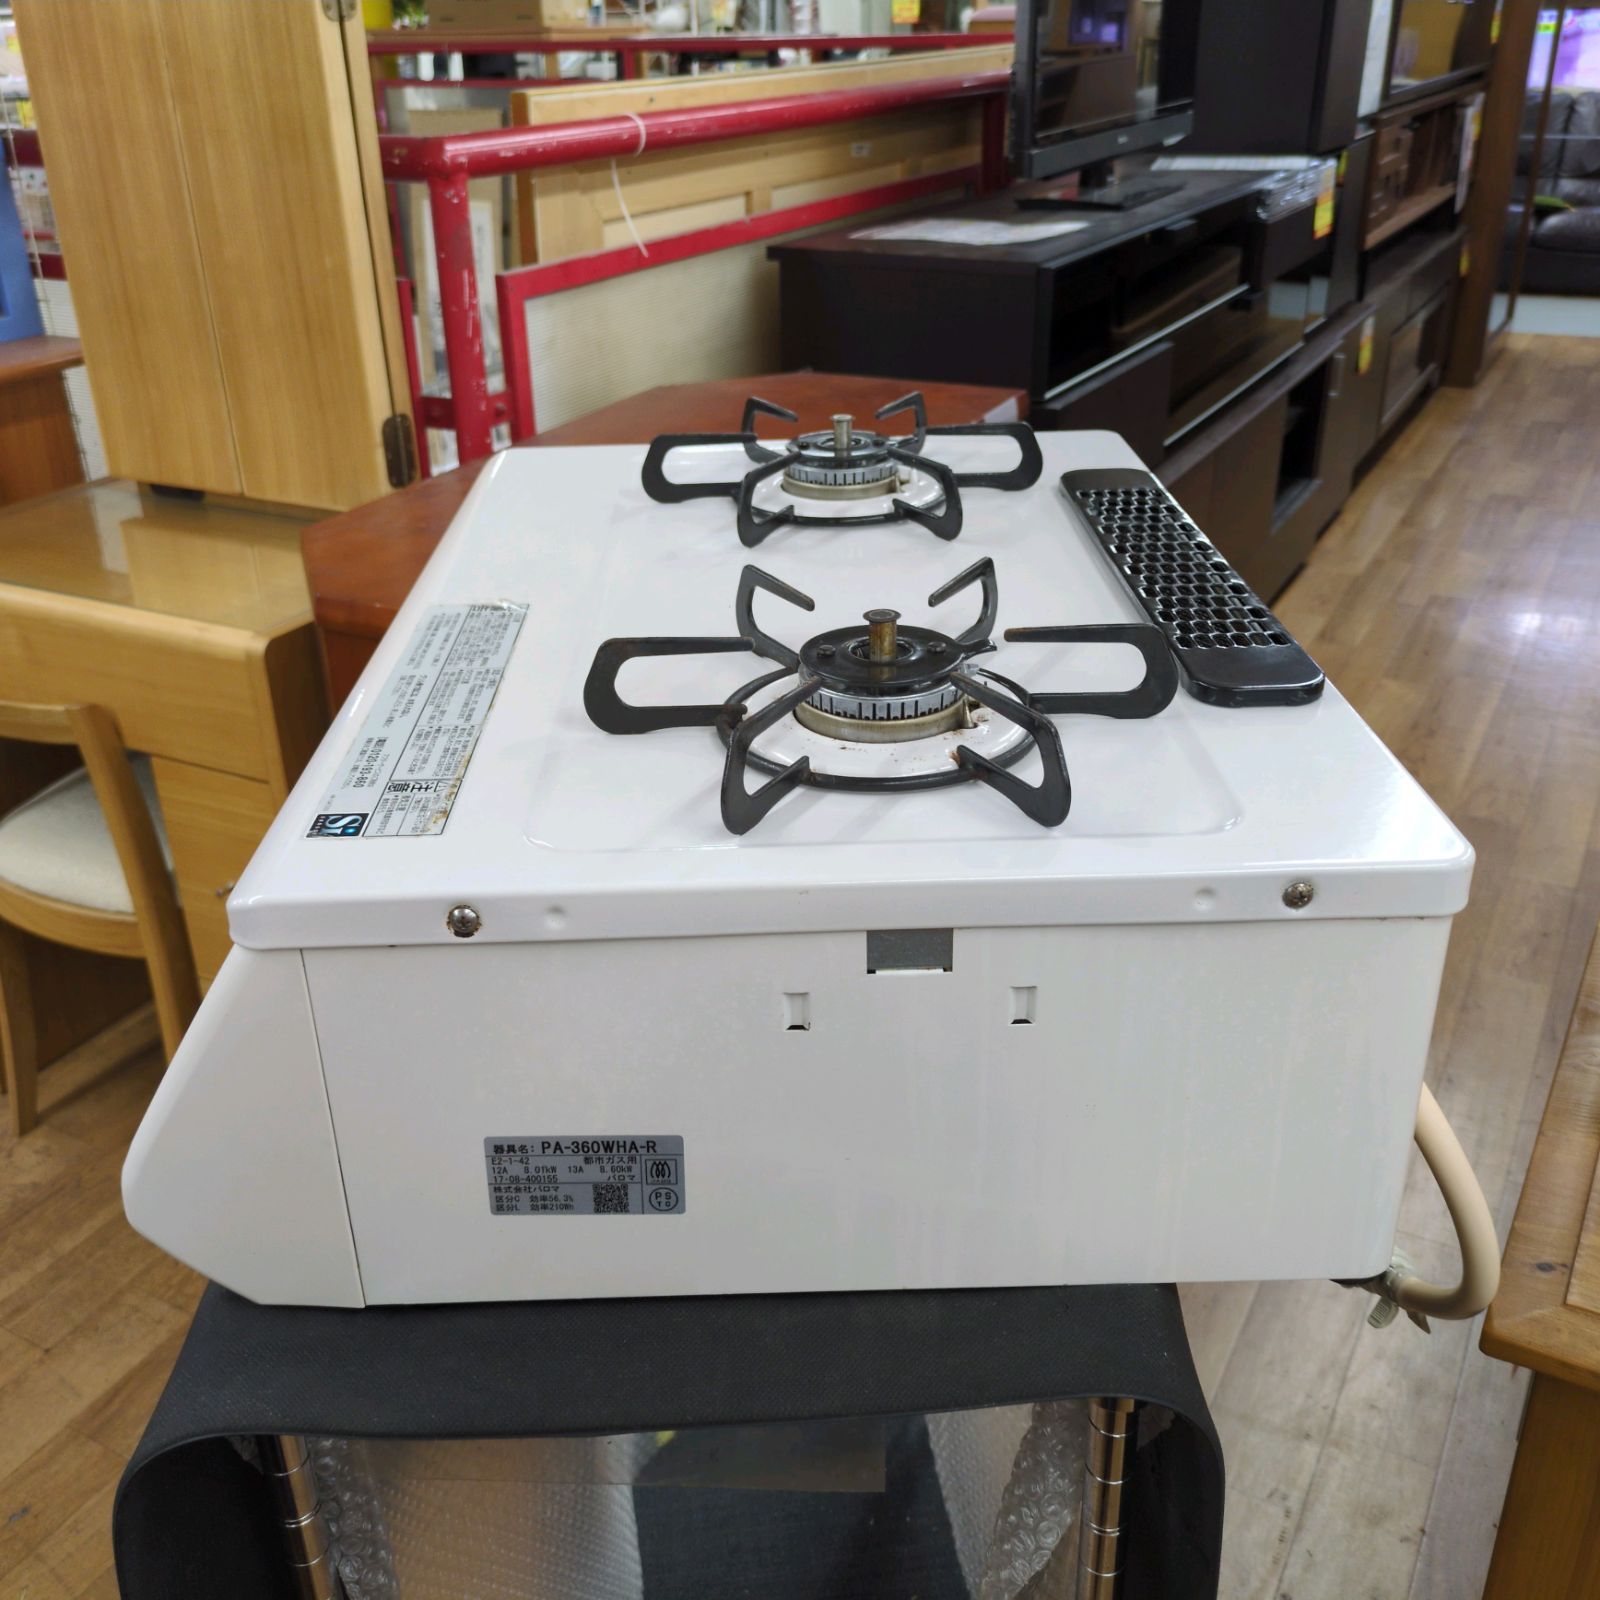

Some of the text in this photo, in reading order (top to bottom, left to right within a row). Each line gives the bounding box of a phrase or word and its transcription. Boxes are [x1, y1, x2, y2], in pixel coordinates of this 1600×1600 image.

[387, 781, 435, 793] 注意
[541, 1140, 657, 1154] PA-360WHA-R
[491, 1157, 530, 1165] E2-1-42
[583, 1155, 637, 1165] 都市ガス用
[492, 1166, 508, 1174] 12A
[568, 1165, 584, 1173] 13A
